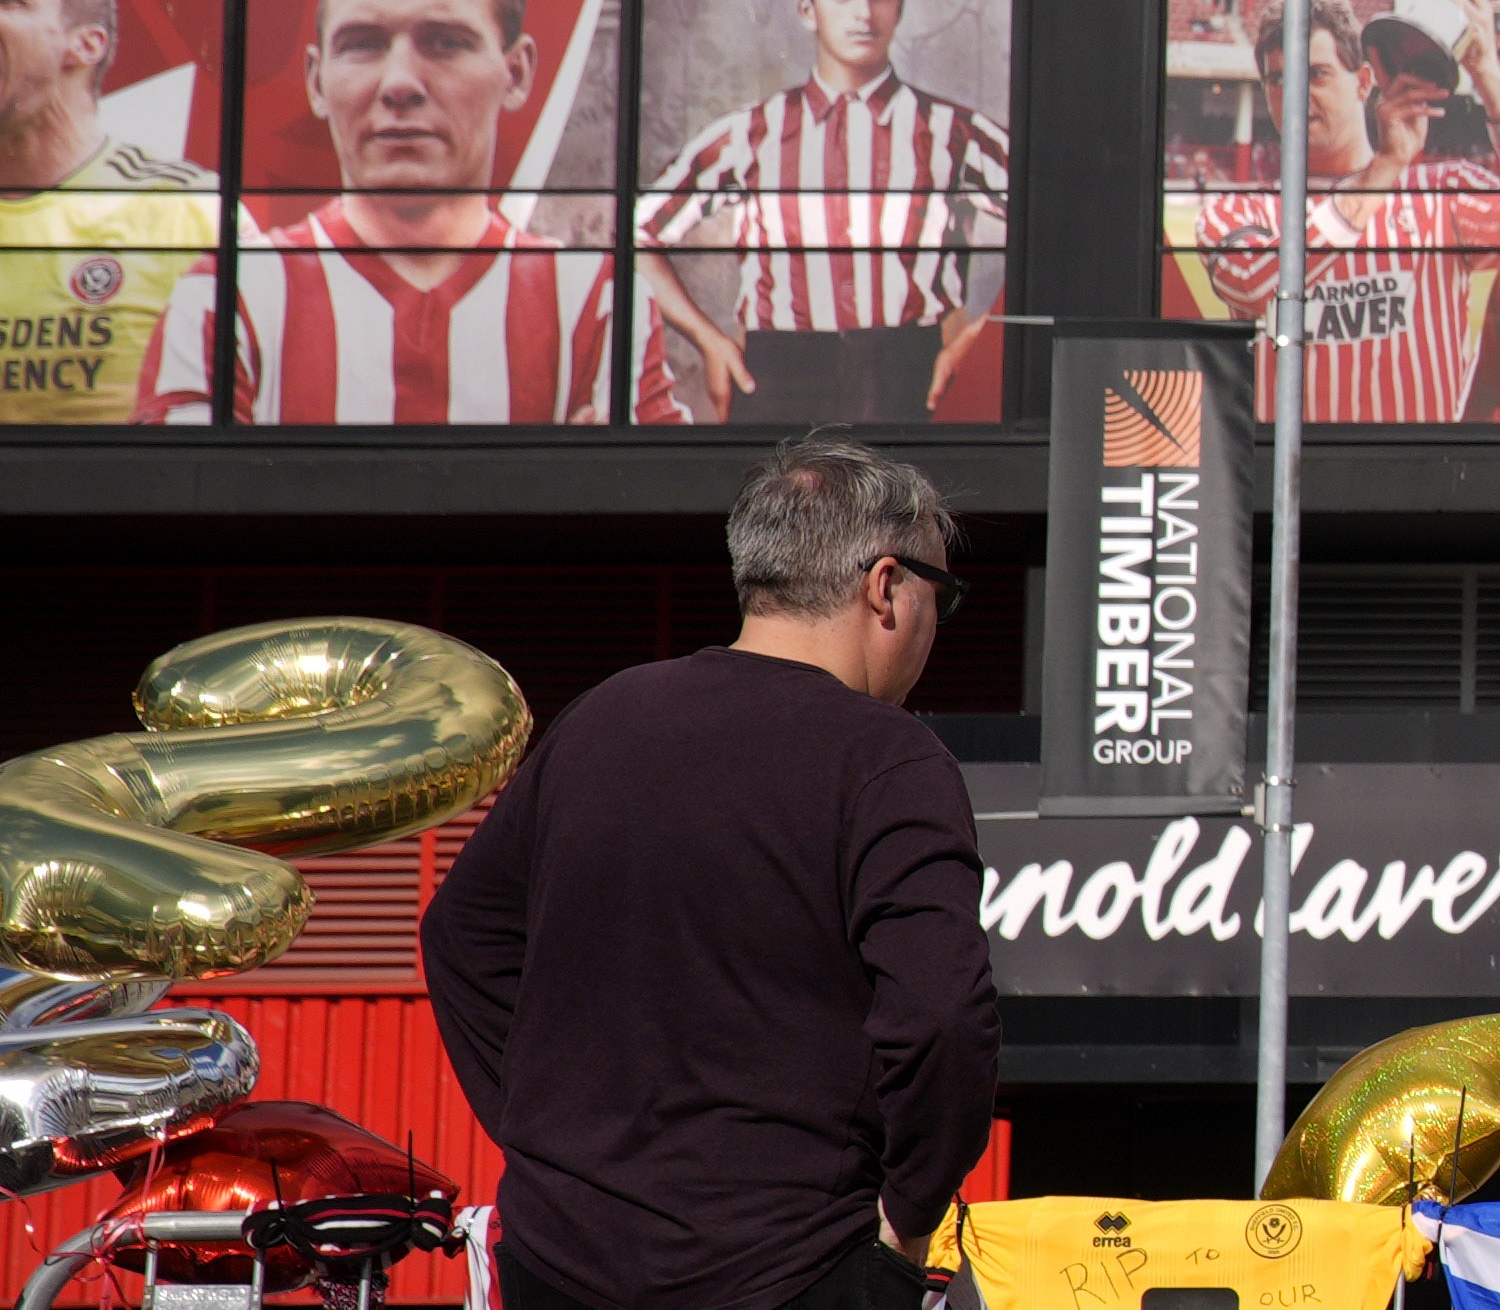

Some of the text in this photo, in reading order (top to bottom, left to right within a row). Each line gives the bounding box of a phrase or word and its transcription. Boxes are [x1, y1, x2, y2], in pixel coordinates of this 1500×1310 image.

[1311, 276, 1397, 302] ARNOLD
[1094, 473, 1153, 735] TIMBER
[1151, 472, 1200, 735] NATIONAL
[1093, 738, 1193, 765] GROUP
[1091, 1234, 1132, 1249] errea
[1185, 1247, 1221, 1264] TO
[1259, 1283, 1323, 1308] OUR
